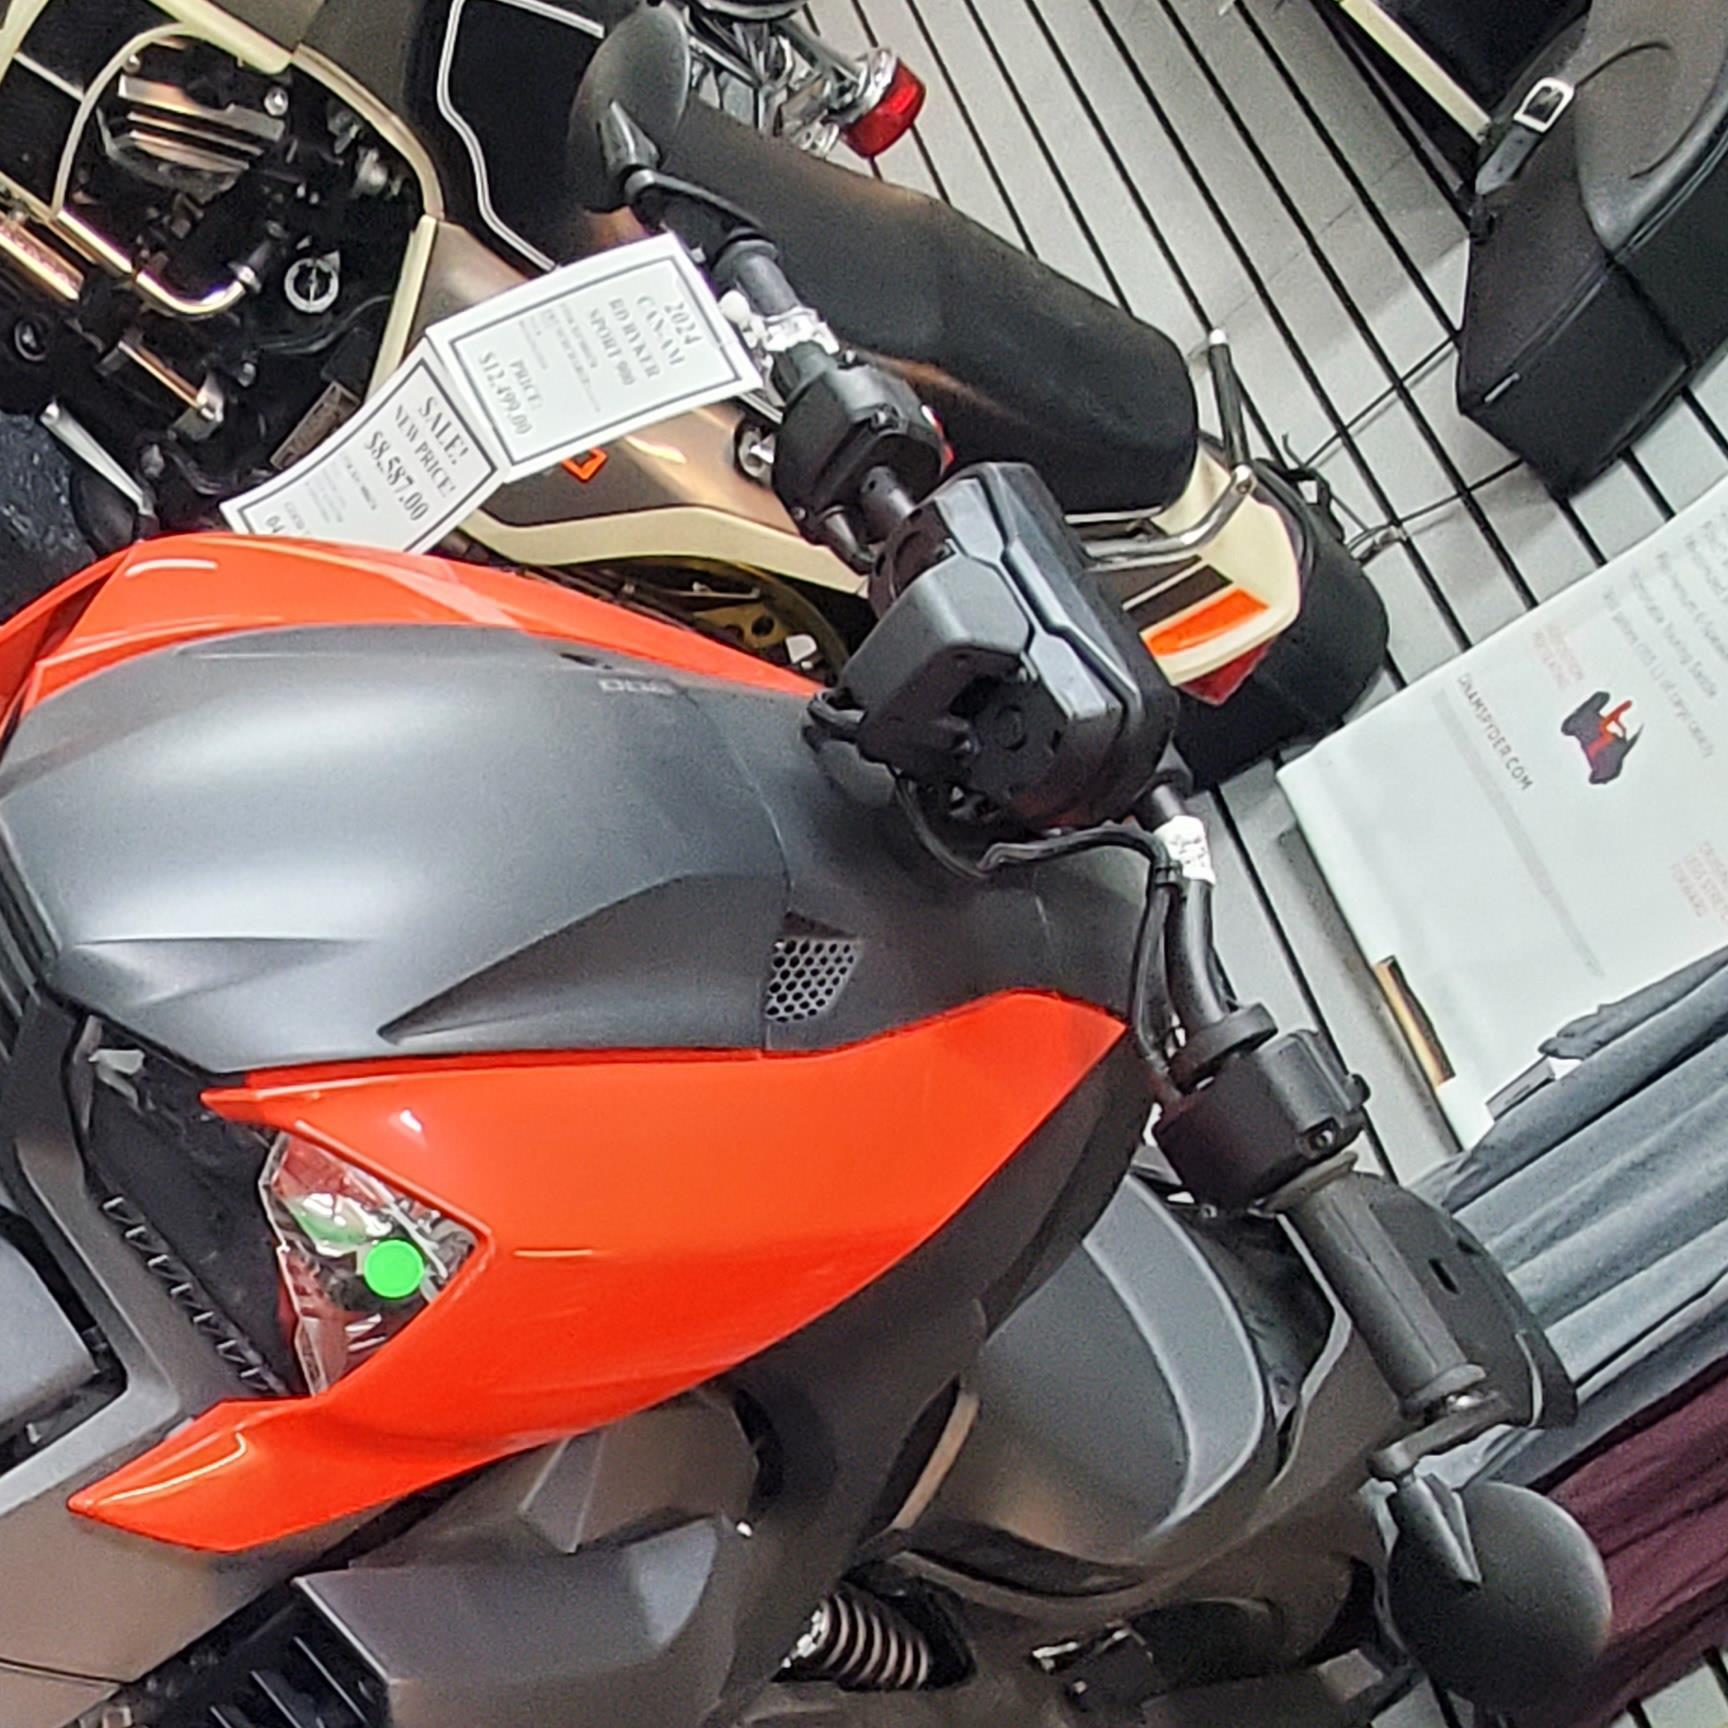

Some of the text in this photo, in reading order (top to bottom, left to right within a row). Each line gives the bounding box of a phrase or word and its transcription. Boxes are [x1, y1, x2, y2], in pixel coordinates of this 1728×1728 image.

[585, 308, 622, 360] SPORT
[620, 321, 660, 378] RYKER
[634, 294, 684, 366] CAN-AM
[663, 300, 702, 346] 2024
[391, 404, 457, 498] NEW PRICE!
[416, 396, 471, 464] SALE!
